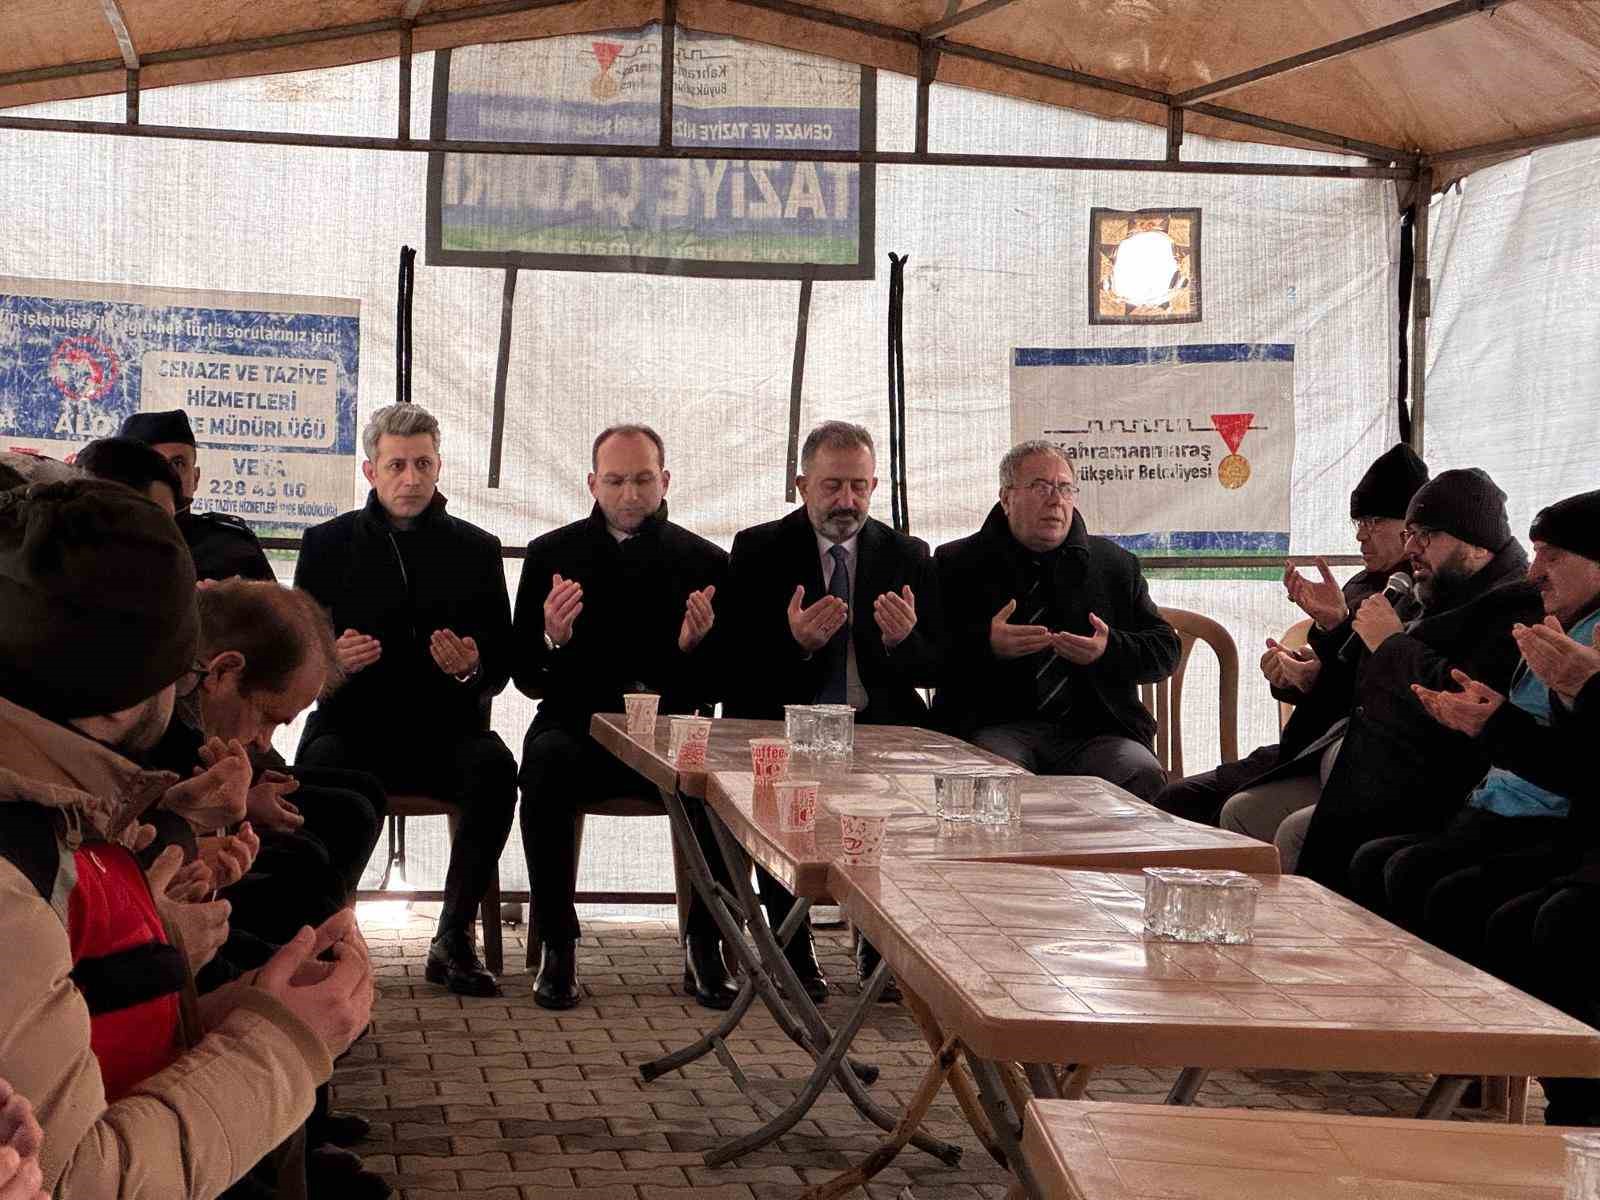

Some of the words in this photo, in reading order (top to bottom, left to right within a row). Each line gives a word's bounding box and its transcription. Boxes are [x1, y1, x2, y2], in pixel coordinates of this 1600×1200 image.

[226, 324, 307, 343] sorularınız
[235, 363, 259, 382] VE
[264, 363, 328, 385] TAZİYE
[187, 385, 297, 411] HİZMETLERİ
[209, 413, 326, 440] MÜDÜRLÜĞÜ
[1076, 463, 1134, 485] ükşehir
[209, 479, 247, 496] 228
